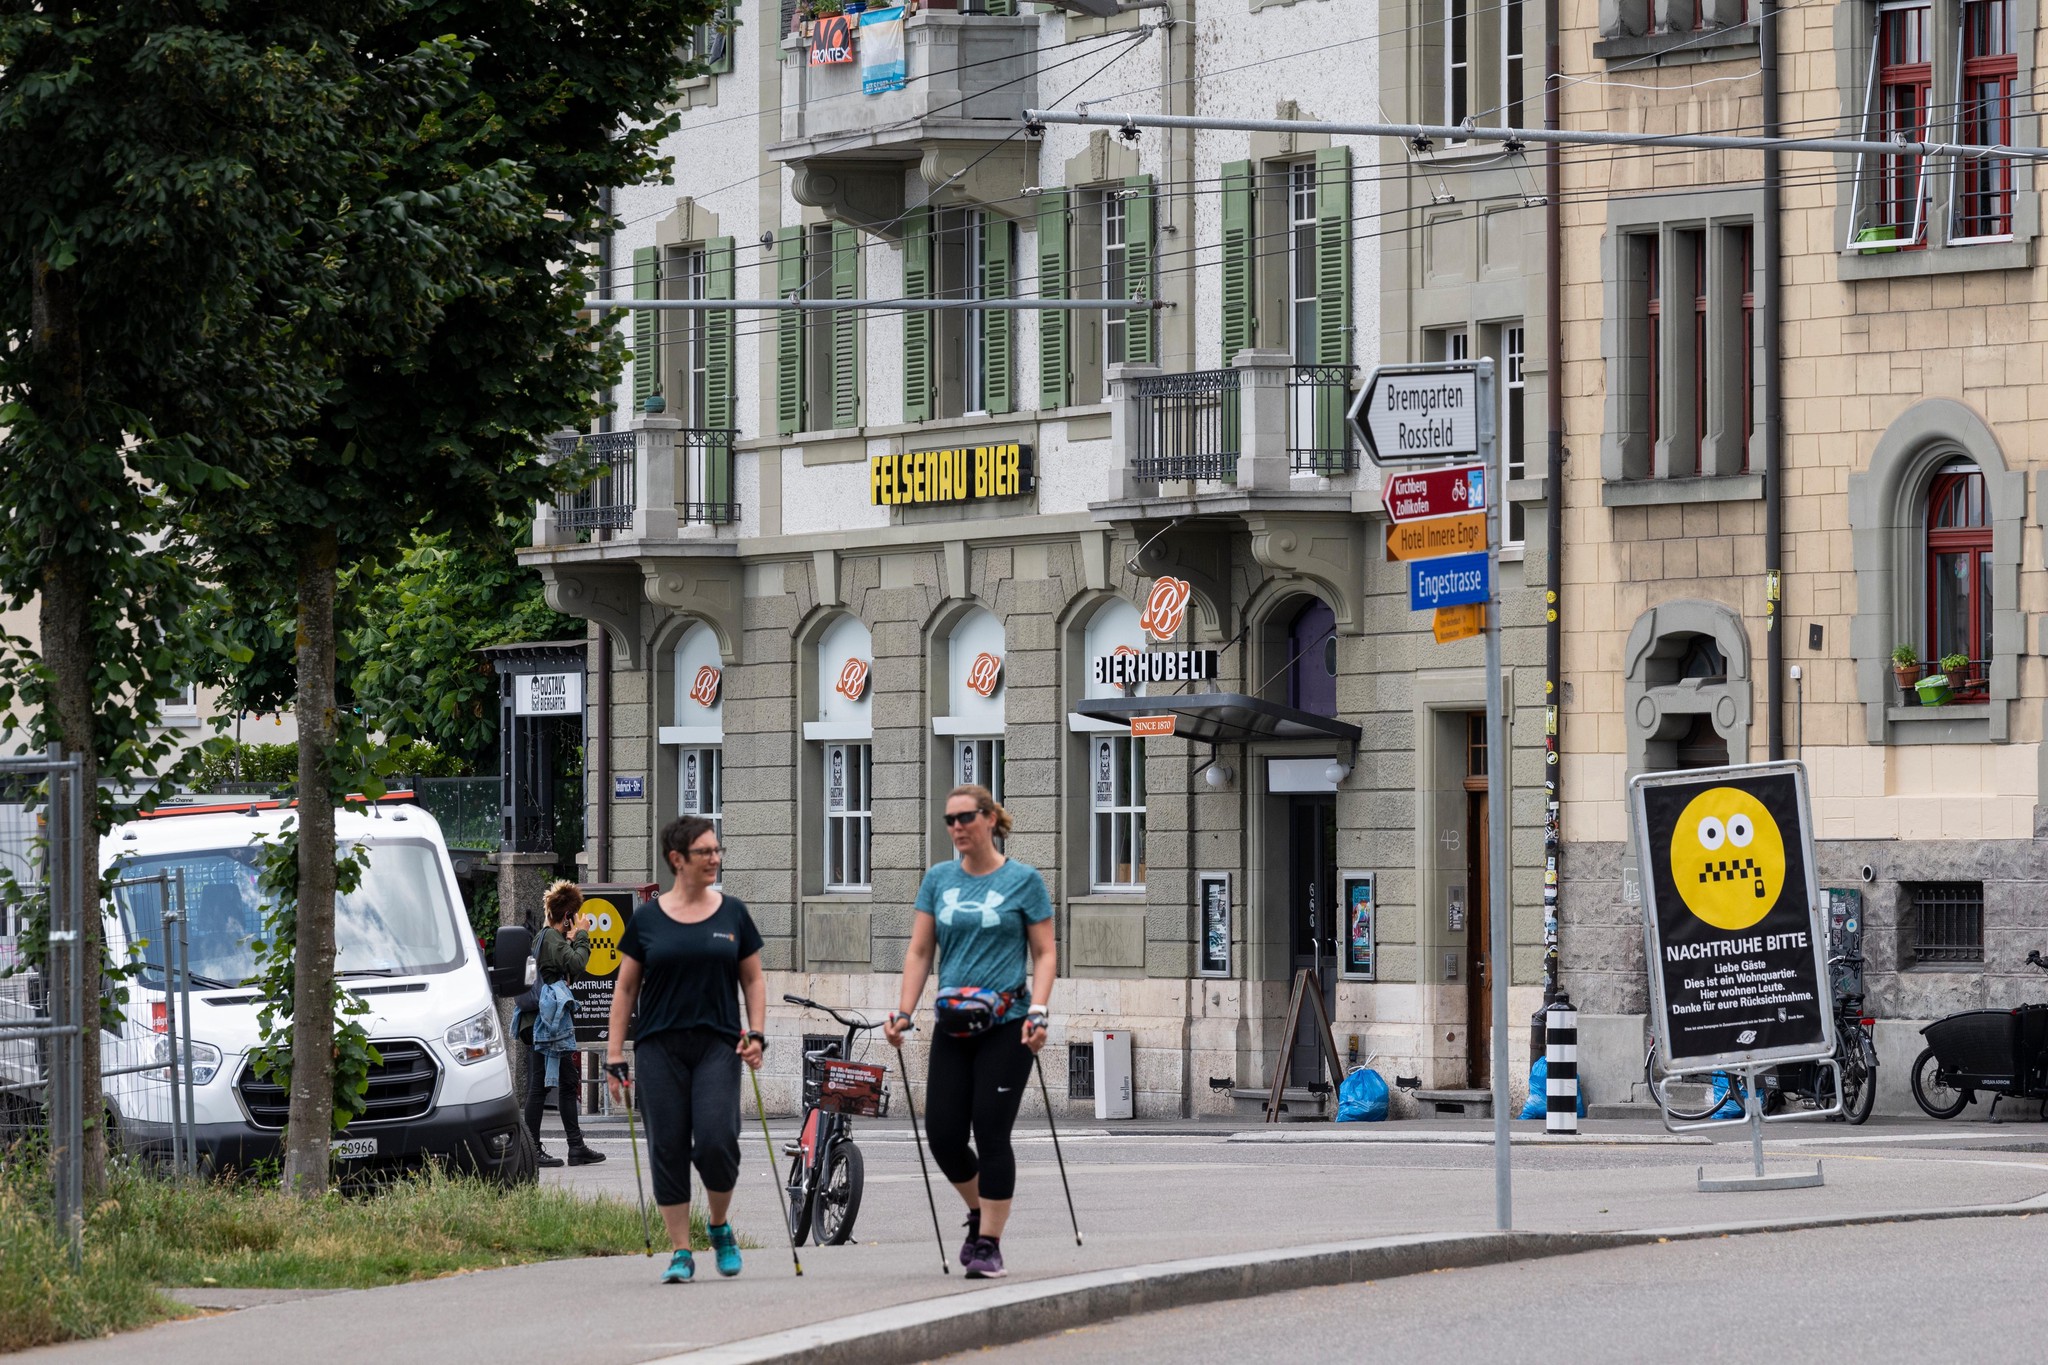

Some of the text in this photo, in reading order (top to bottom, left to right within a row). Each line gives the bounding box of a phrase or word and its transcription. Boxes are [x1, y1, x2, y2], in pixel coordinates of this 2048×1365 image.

[811, 17, 850, 62] NO
[811, 47, 851, 64] FRONTEX
[1387, 384, 1463, 417] Bremgarten
[1399, 418, 1453, 450] Rossfeld
[871, 444, 1019, 506] FELSENAU BIER
[1395, 478, 1427, 498] Kirchberg
[1468, 484, 1483, 508] 34
[1396, 499, 1429, 516] Zollikofen
[1401, 522, 1479, 550] Hotel Innere Enge
[1418, 569, 1481, 603] Engestrasse
[1093, 650, 1206, 684] BIERHÜBELI
[540, 676, 566, 696] GUSTAVS
[540, 697, 566, 711] BIERGARTEN
[1135, 720, 1171, 731] SINCE 1870
[1440, 829, 1460, 850] 43
[1667, 937, 1762, 962] NACHTRUHE
[1766, 932, 1807, 951] BITTE
[1714, 960, 1766, 974] Liebe Gäste
[569, 980, 612, 990] ACHTRUHE
[1684, 969, 1797, 989] Dies ist ein Wohnquartier.
[1700, 982, 1785, 1000] Hier wohnen Leute.
[1672, 992, 1813, 1015] Danke für eure Rücksichtnahme.
[341, 1141, 374, 1154] 80966
